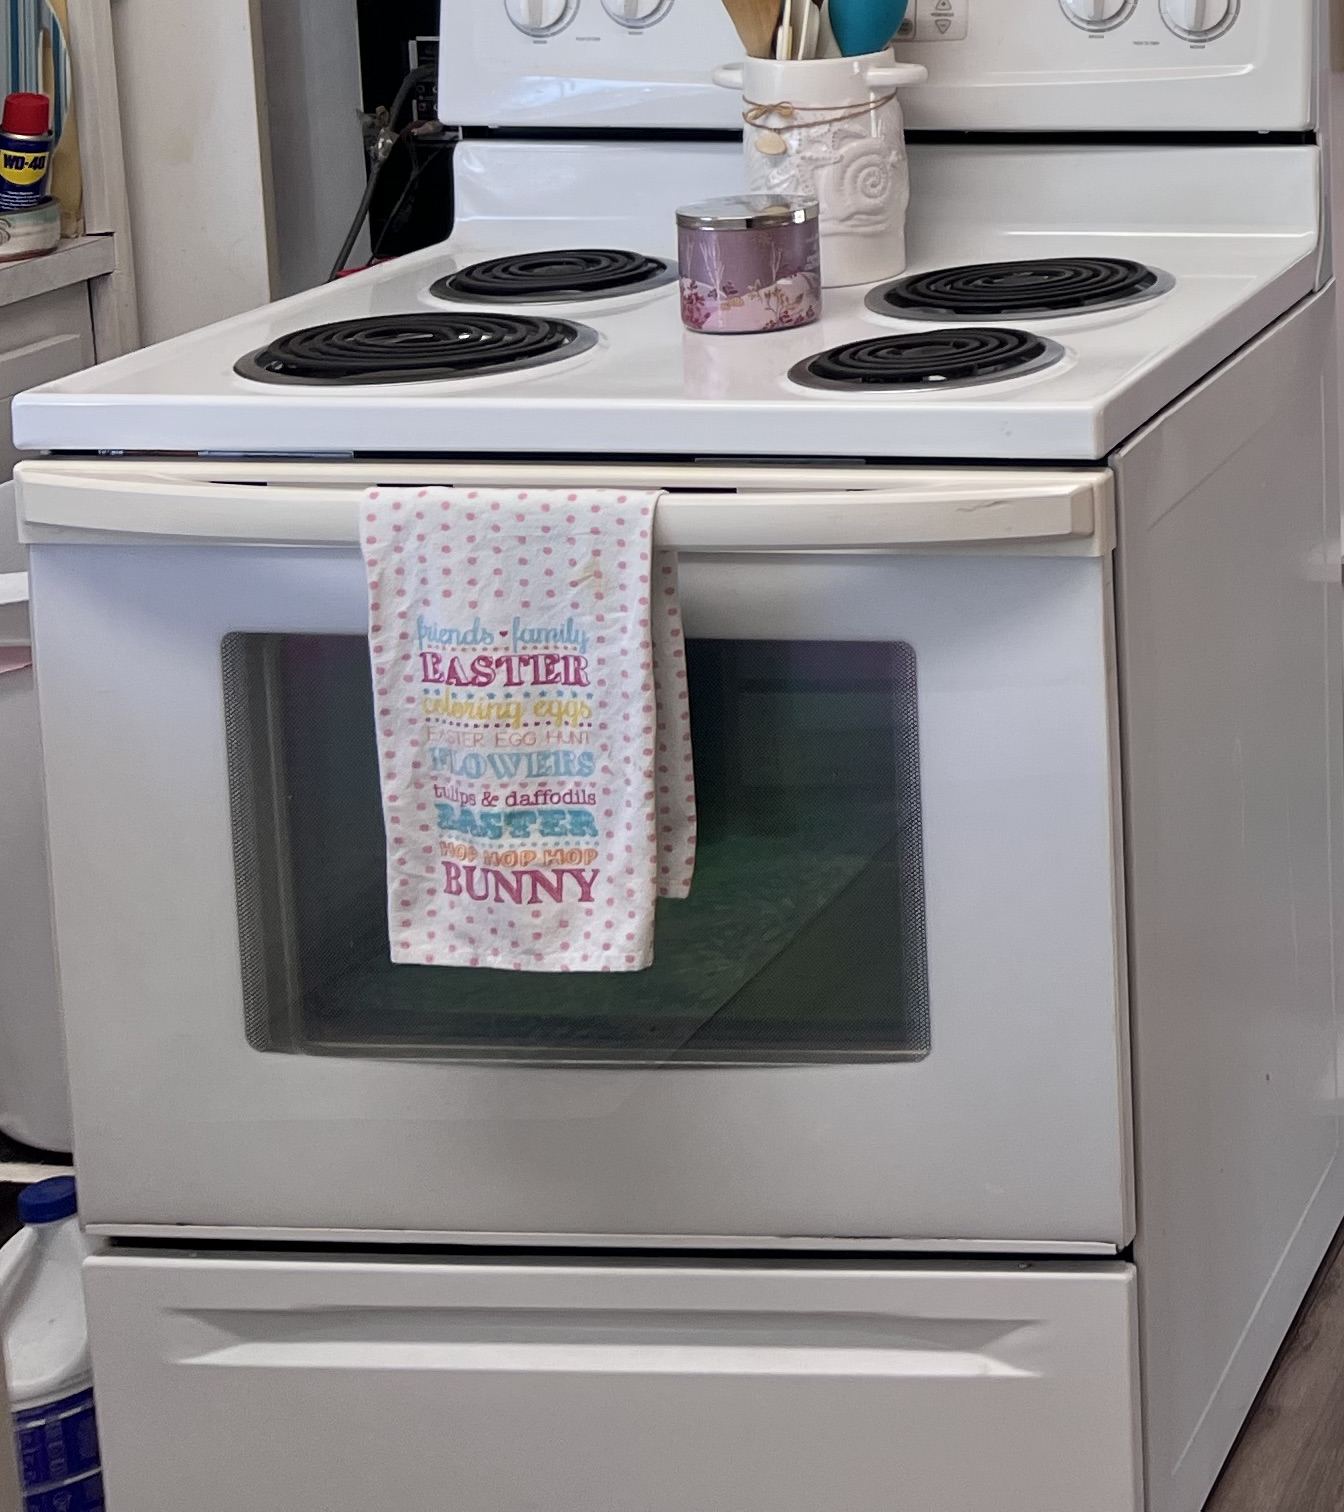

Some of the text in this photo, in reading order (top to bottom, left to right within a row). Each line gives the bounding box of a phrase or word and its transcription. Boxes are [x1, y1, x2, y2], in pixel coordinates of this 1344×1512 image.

[3, 152, 46, 171] WD-40
[416, 614, 590, 654] friends family
[419, 651, 592, 688] EASTER
[422, 689, 593, 729] coloring eggs
[426, 726, 591, 748] EASTER EGG HUNT
[429, 747, 597, 780] FLOWERS
[433, 783, 597, 808] tulips & daffodils
[434, 803, 599, 840] EASTER
[438, 841, 599, 867] HOP HOP HOP
[441, 861, 601, 905] BUNNY
